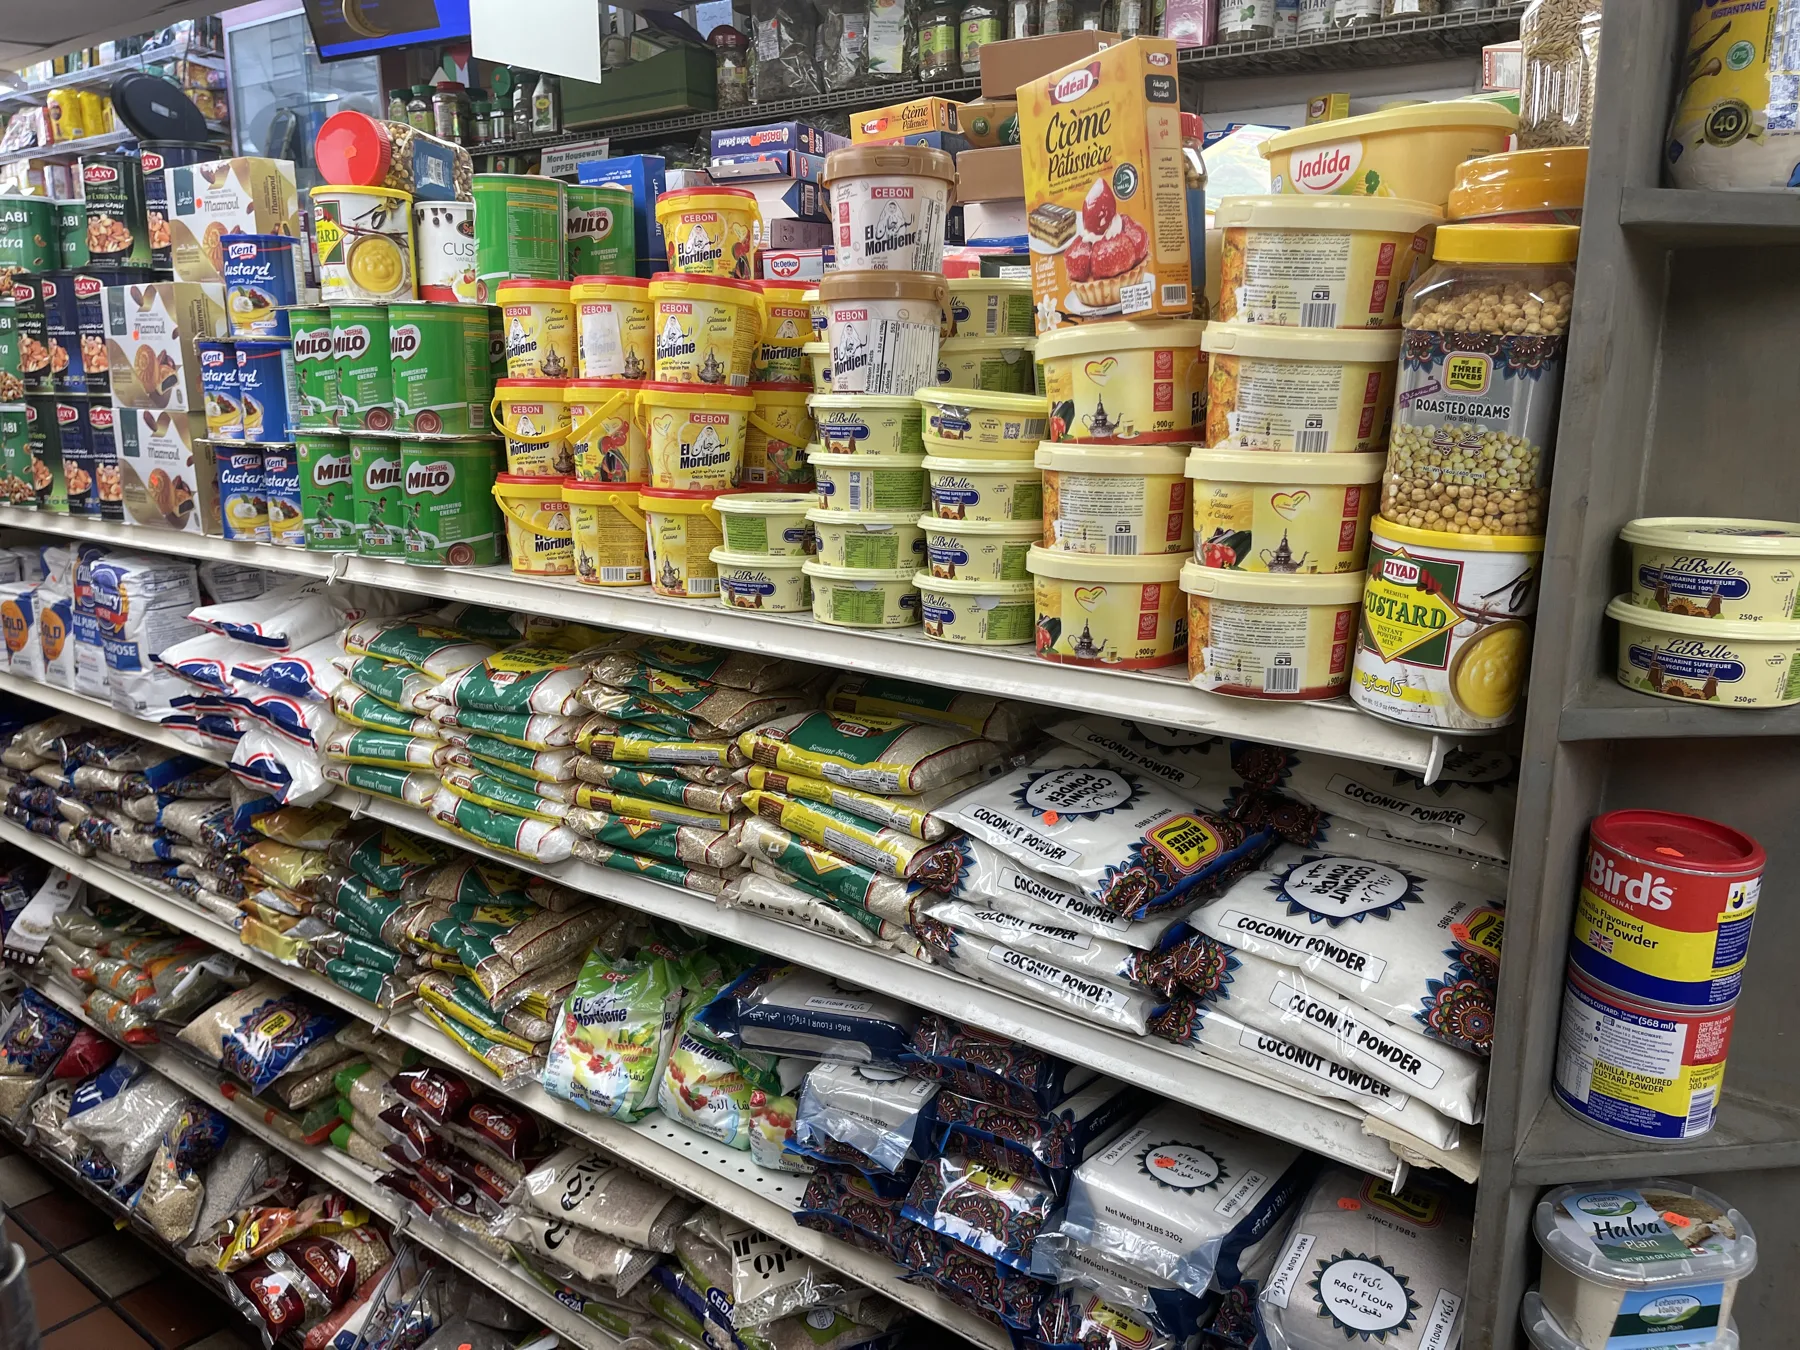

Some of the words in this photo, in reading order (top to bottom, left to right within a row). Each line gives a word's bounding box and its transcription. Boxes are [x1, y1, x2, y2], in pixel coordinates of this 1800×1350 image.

[1711, 1, 1766, 20] INSTANTANE
[1058, 74, 1089, 98] Idéal
[902, 105, 929, 120] Crème
[1046, 108, 1112, 153] Crème
[1714, 115, 1737, 131] 40
[547, 153, 563, 163] More
[565, 149, 603, 160] Houseware
[1048, 144, 1112, 182] Pâtissière
[551, 163, 575, 174] UPPER
[875, 188, 910, 198] CEBON
[568, 217, 608, 234] MILO
[684, 215, 714, 223] CEBON
[865, 225, 874, 240] El
[231, 245, 253, 255] Kent
[678, 243, 685, 255] El
[678, 248, 722, 268] Mordjene
[224, 261, 270, 276] Custard
[506, 307, 529, 316] CEBON
[583, 306, 608, 314] CEBON
[661, 304, 689, 313] CEBON
[775, 308, 807, 317] CEBON
[837, 311, 864, 320] CEBON
[296, 338, 332, 356] MILO
[334, 337, 365, 354] MILO
[657, 342, 695, 361] Mordjene
[203, 352, 220, 361] Kent
[1451, 372, 1482, 381] RIVERS
[1453, 365, 1482, 375] THREE
[512, 406, 540, 414] CEBON
[1416, 399, 1466, 415] ROASTED
[1468, 403, 1511, 419] GRAMS
[693, 414, 727, 424] CEBON
[1459, 416, 1477, 424] Skin)
[681, 443, 690, 456] El
[234, 455, 258, 465] Kent
[267, 458, 284, 467] Kent
[680, 450, 731, 470] Mordjene
[408, 472, 449, 488] MILO
[1213, 489, 1228, 498] Pour
[1214, 509, 1234, 520] Cuisine
[1385, 560, 1418, 580] ZIYAD
[1667, 556, 1736, 576] LaBelle
[1663, 574, 1696, 584] MARGARINE
[1698, 578, 1736, 586] SUPERIEURE
[1671, 582, 1696, 591] VEGETALE
[1383, 588, 1410, 600] PREMIUM
[1365, 589, 1447, 630] CUSTARD
[1376, 630, 1403, 643] POWDER
[1377, 625, 1404, 637] INSTANT
[1382, 638, 1394, 647] MIX
[1660, 637, 1732, 659] LaBelle
[1657, 655, 1692, 666] MARGARINE
[1693, 660, 1732, 669] SUPERIEURE
[1666, 663, 1692, 673] VEGETALE
[839, 724, 866, 736] ZIYAD
[808, 743, 835, 755] Sesame
[835, 749, 857, 761] Seeds
[1086, 732, 1138, 763] COCONUT
[1137, 756, 1185, 783] POWDER
[1045, 773, 1096, 803] POWDER
[1062, 777, 1113, 808] COCONUT
[1344, 783, 1410, 812] COCONUT
[1410, 806, 1466, 826] POWDER
[810, 802, 836, 815] Sesame
[834, 812, 856, 824] Seeds
[1153, 807, 1172, 820] SINCE
[1134, 817, 1153, 829] 1985
[973, 808, 1023, 840] COCONUT
[1023, 830, 1067, 861] POWDER
[1166, 826, 1202, 847] RIVERS
[1174, 831, 1209, 855] THREE
[1309, 863, 1351, 895] POWDER
[1328, 865, 1377, 905] COCONUT
[1590, 851, 1673, 911] Bird's
[1014, 875, 1066, 904] COCONUT
[1066, 897, 1118, 924] POWDER
[1600, 891, 1634, 911] ORIGINAL
[1447, 900, 1467, 920] SINCE
[1436, 916, 1450, 930] 1985
[1600, 909, 1644, 932] Flavoured
[1028, 919, 1079, 941] POWDER
[1605, 919, 1659, 949] Powder
[1237, 916, 1304, 947] COCONUT
[1305, 937, 1367, 973] POWDER
[1003, 950, 1061, 982] COCONUT
[1062, 972, 1113, 1002] POWDER
[573, 997, 582, 1012] El
[1594, 1000, 1619, 1016] CUSTARD:
[573, 1007, 627, 1027] Mordjene
[815, 1020, 833, 1030] FLOUR
[1638, 1016, 1659, 1028] (568
[1661, 1022, 1674, 1031] ml)
[835, 1023, 851, 1032] RAGI
[1288, 994, 1357, 1038] COCONUT
[1357, 1030, 1422, 1076] POWDER
[1257, 1036, 1325, 1072] COCONUT
[1328, 1064, 1391, 1098] POWDER
[1595, 1060, 1625, 1076] VANILLA
[1626, 1072, 1672, 1087] FLAVOURED
[1593, 1067, 1628, 1085] CUSTARD
[1629, 1080, 1664, 1093] POWDER
[1688, 1082, 1702, 1090] 300
[1184, 1163, 1212, 1179] FLOUR
[1587, 1194, 1619, 1203] Lebanon
[1593, 1199, 1620, 1208] Valley
[1105, 1206, 1118, 1216] Net
[1119, 1209, 1146, 1228] Weight
[1146, 1222, 1164, 1235] 2LBS
[1165, 1229, 1183, 1244] 32Oz
[1366, 1213, 1393, 1230] SINCE
[1395, 1224, 1416, 1239] 1985
[1592, 1217, 1662, 1241] Halva
[1297, 1237, 1308, 1253] RAGI
[1624, 1238, 1659, 1250] Plain
[1082, 1256, 1109, 1275] Weight
[1286, 1252, 1301, 1272] FLOUR
[1333, 1279, 1358, 1294] RAGI
[1361, 1290, 1394, 1311] FLOUR
[1654, 1298, 1689, 1307] Lebanon
[710, 1289, 734, 1318] CEDA
[1658, 1304, 1684, 1314] Valley
